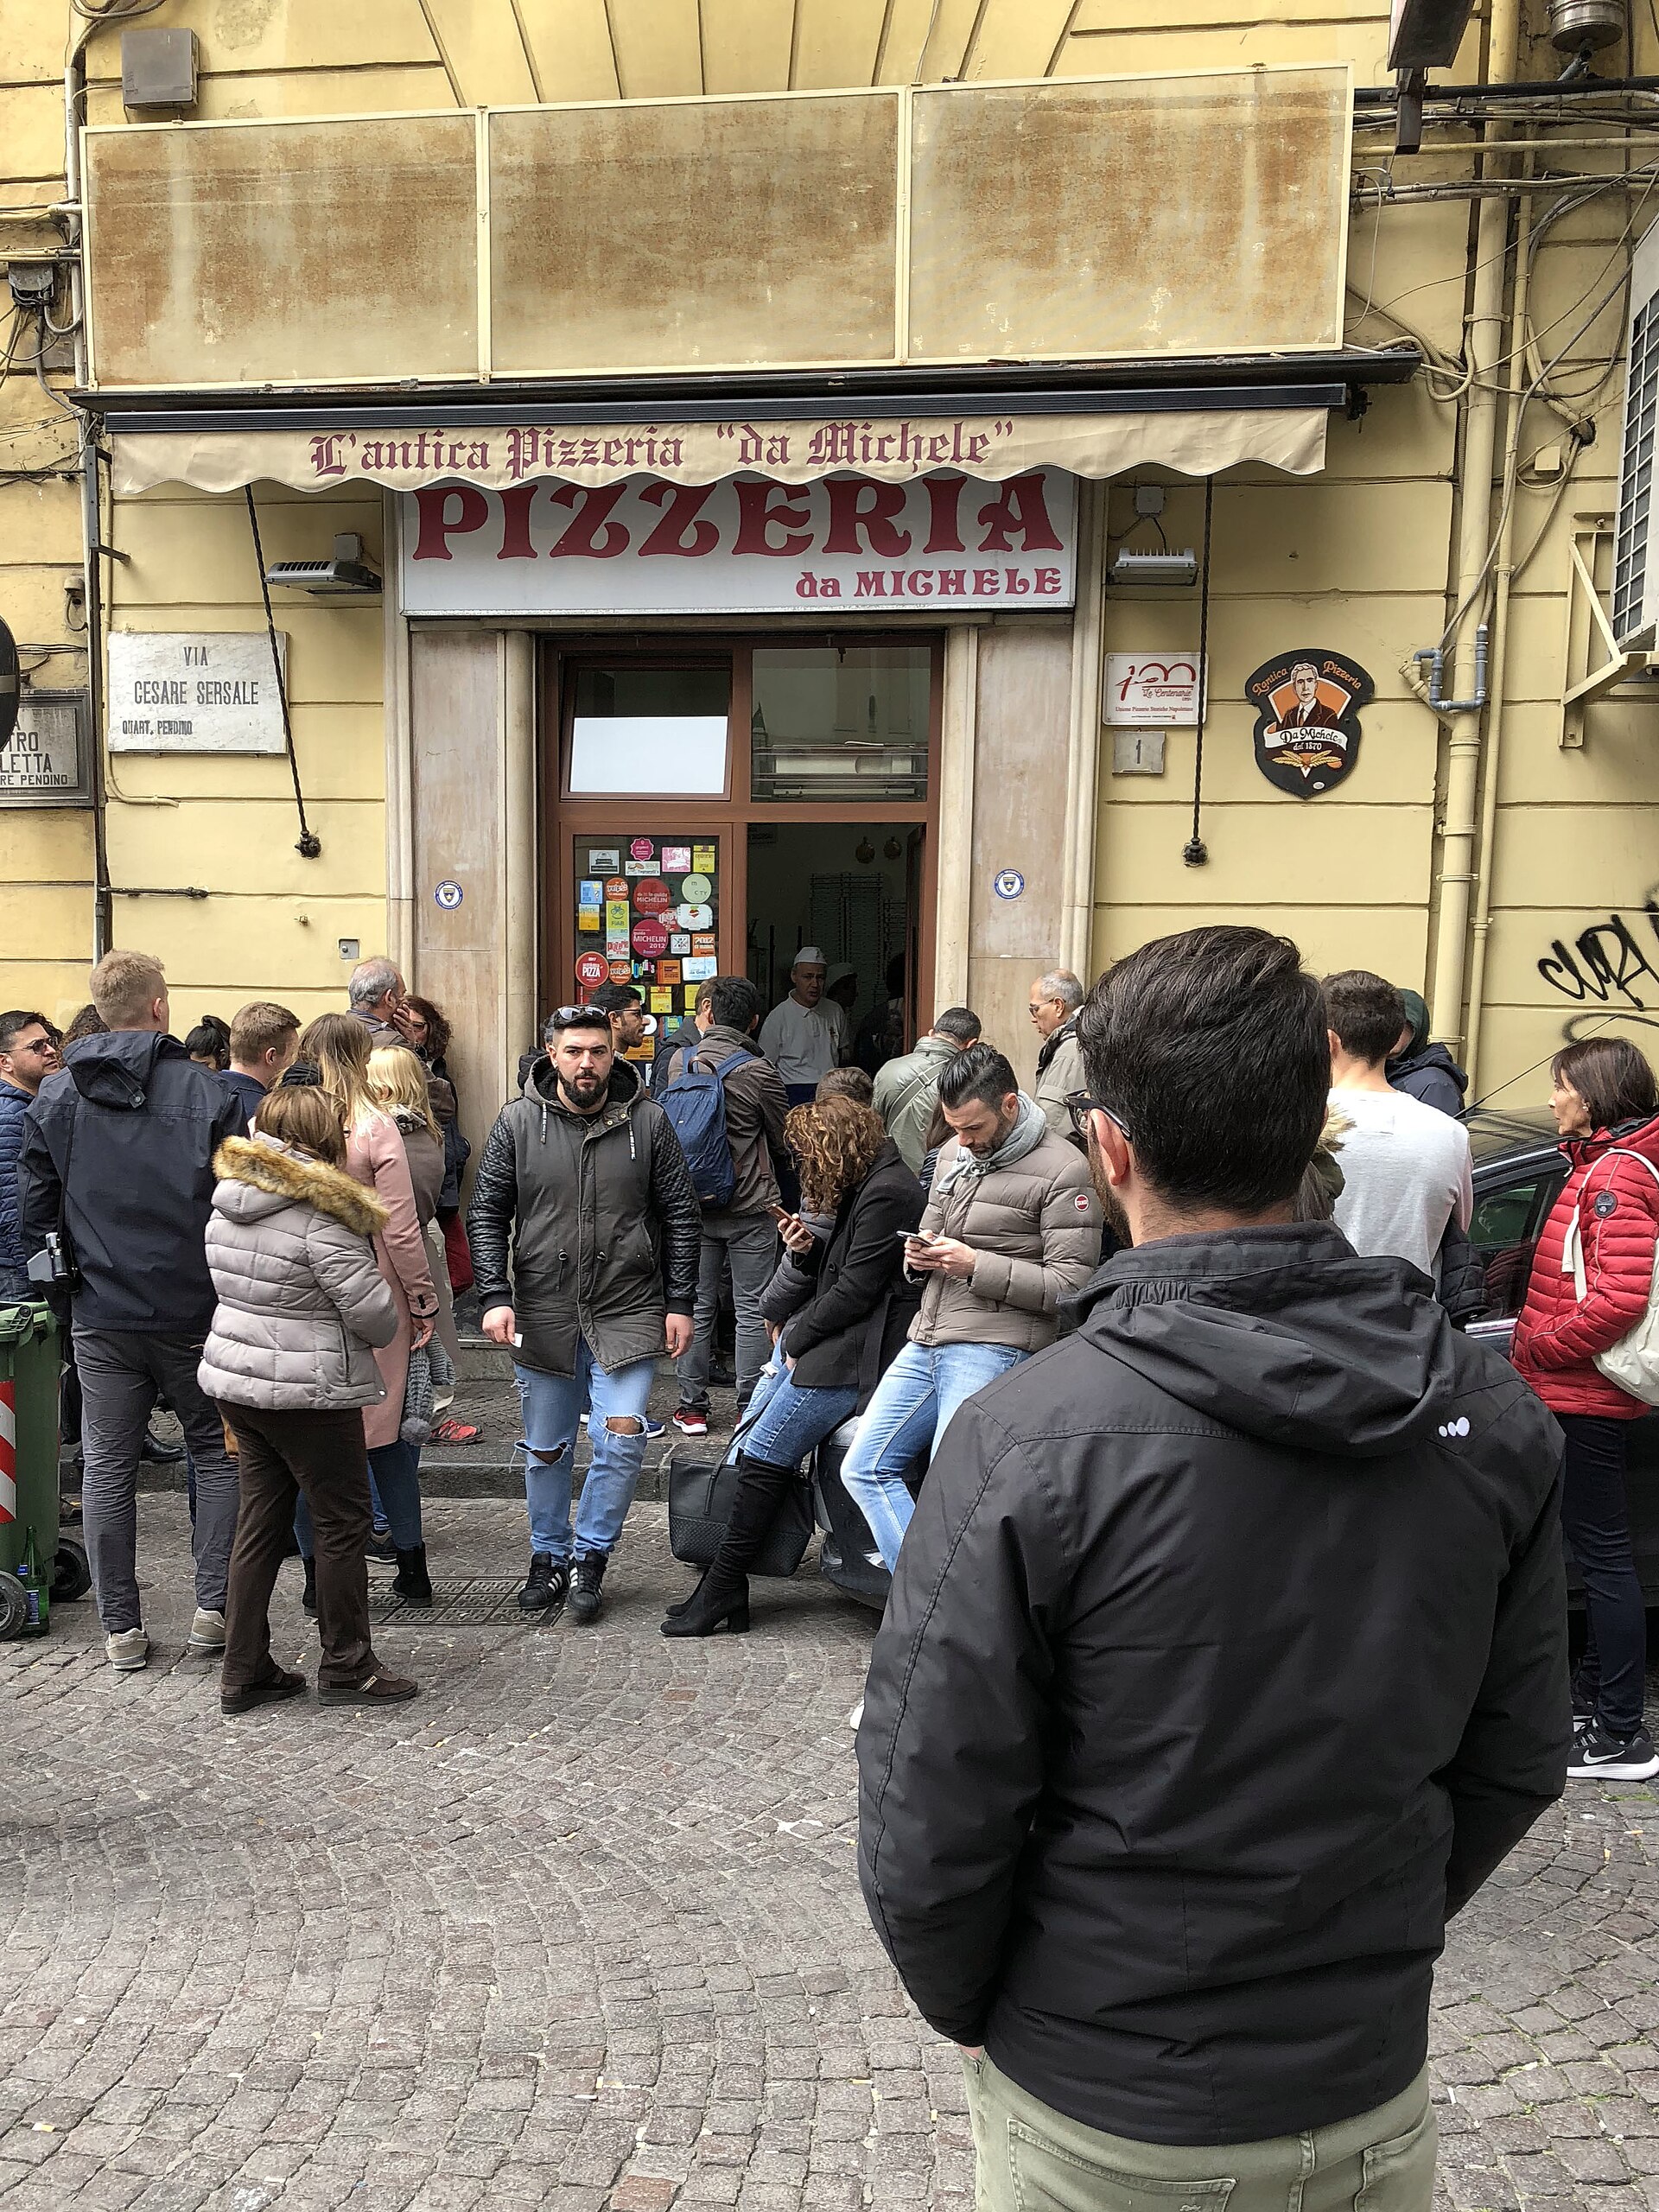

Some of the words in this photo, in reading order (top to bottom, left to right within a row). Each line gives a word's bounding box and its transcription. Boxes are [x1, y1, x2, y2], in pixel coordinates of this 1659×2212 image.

[308, 429, 490, 478] L'antica
[505, 425, 684, 480] Pizzeria
[412, 473, 1065, 560] PIZZERIA
[795, 571, 842, 599] da
[854, 567, 1063, 598] MICHELE
[183, 646, 209, 666] VIA
[1323, 660, 1362, 690] Pizzeria
[134, 680, 188, 704] CESARE
[196, 681, 259, 705] SERSALE
[122, 720, 154, 735] QUART.
[157, 720, 193, 735] PENDINO
[1280, 731, 1299, 744] Da
[1135, 739, 1141, 764] 1
[20, 773, 68, 785] PENDINO
[582, 967, 601, 977] PIZZA
